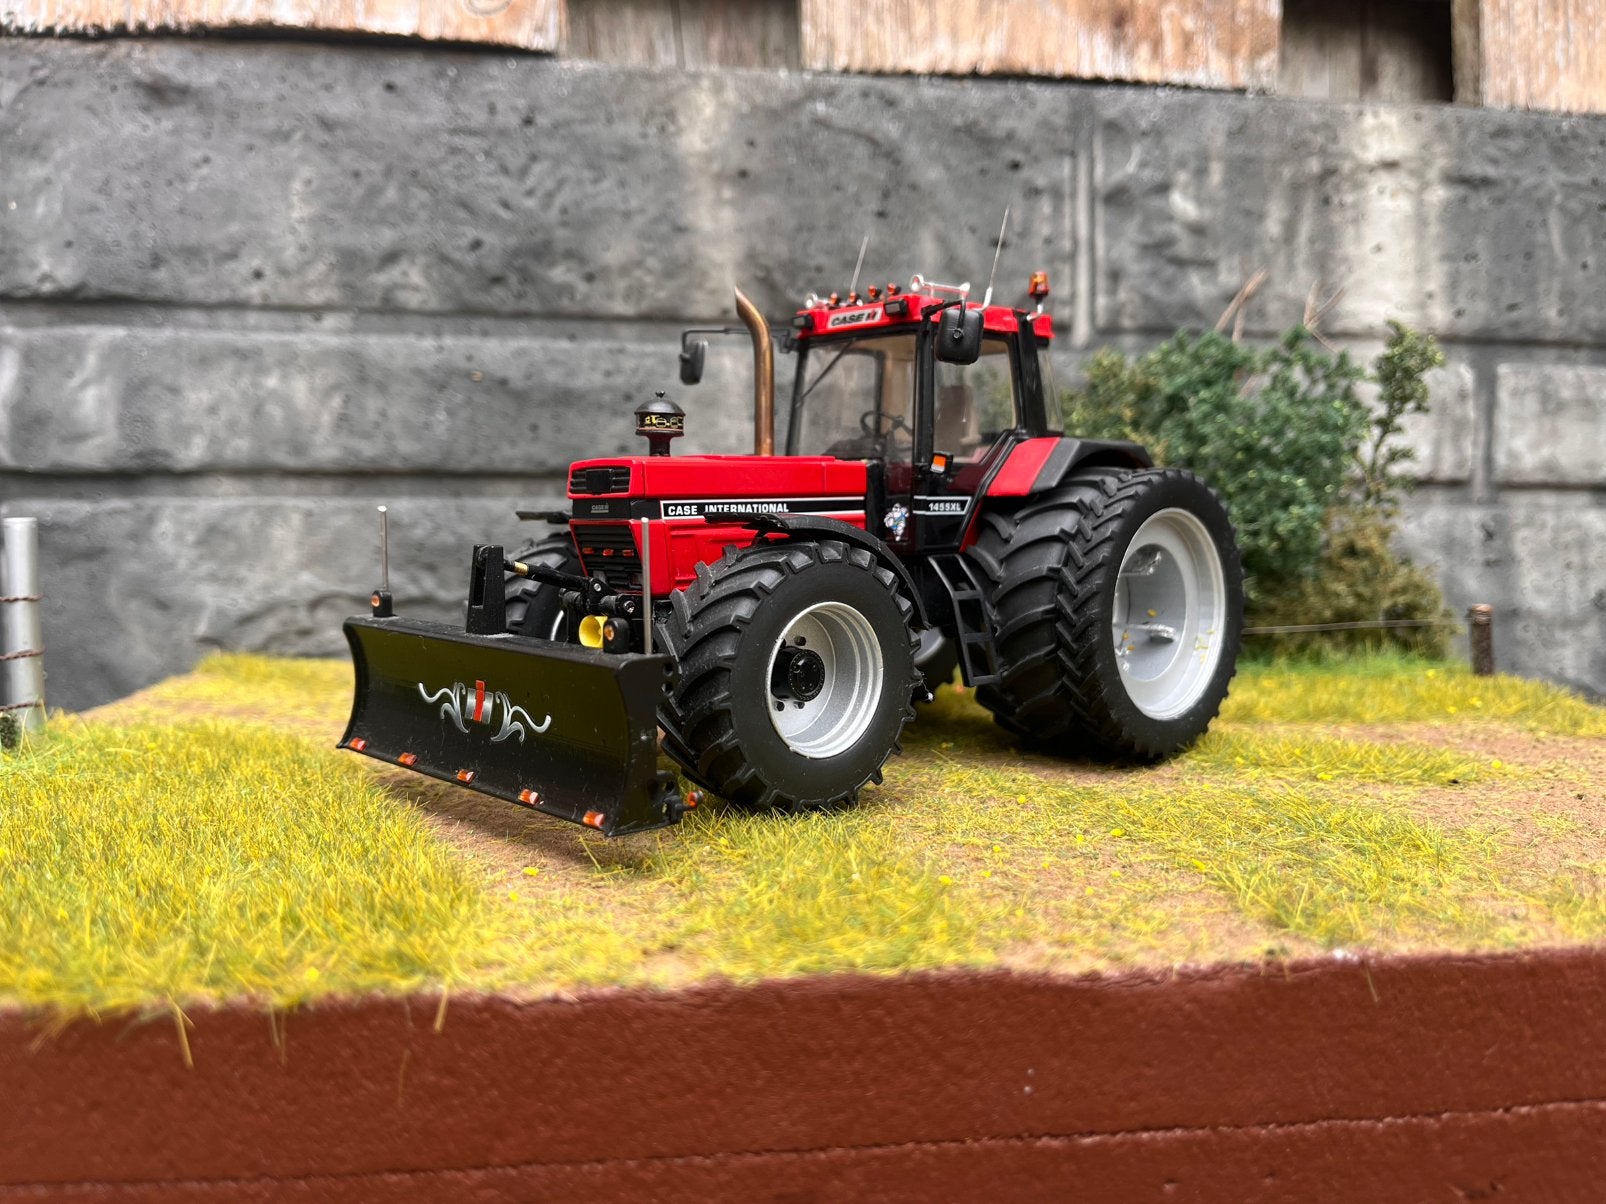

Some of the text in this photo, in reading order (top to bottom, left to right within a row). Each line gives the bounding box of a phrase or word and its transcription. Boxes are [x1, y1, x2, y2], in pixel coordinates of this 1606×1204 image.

[831, 313, 865, 326] CASE
[668, 503, 789, 516] CASE INTERNATIONAL
[928, 502, 961, 512] 1455XL
